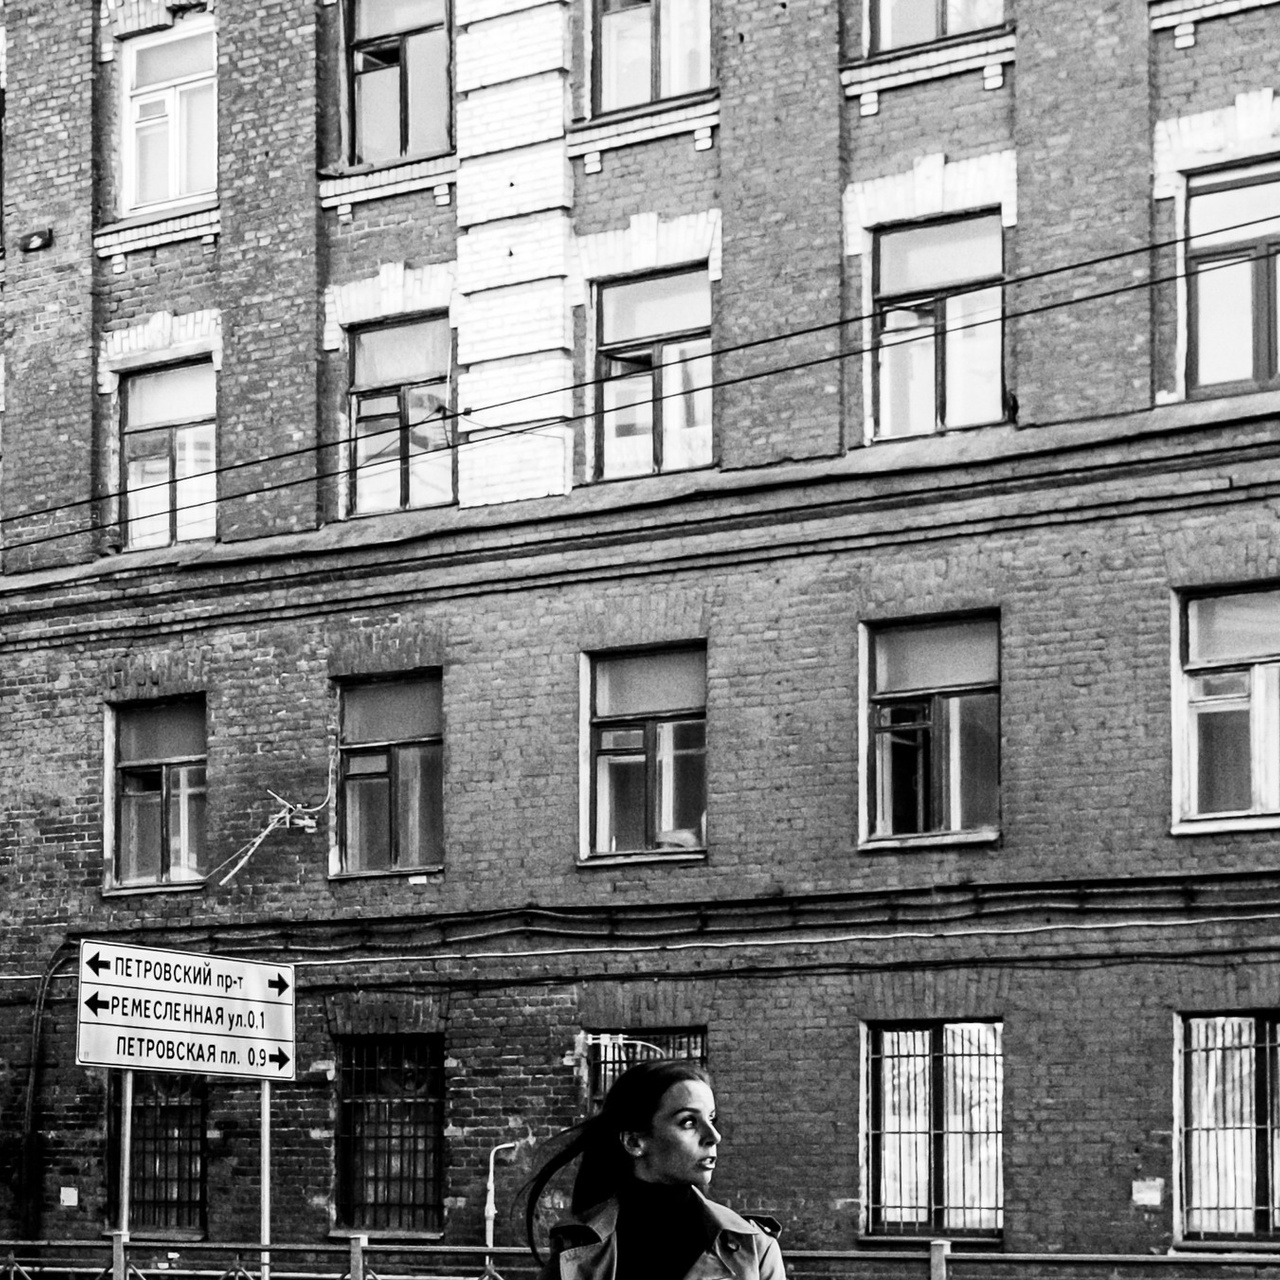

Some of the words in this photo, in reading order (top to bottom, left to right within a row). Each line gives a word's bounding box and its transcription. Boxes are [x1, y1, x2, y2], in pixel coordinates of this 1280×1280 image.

[115, 956, 212, 986] ПЕТРОВСКИЙ
[216, 973, 244, 993] пр-т
[111, 995, 224, 1026] РЕМЕСЛЕННАЯ
[116, 1035, 216, 1063] ПЕТРОВСКАЯ
[220, 1050, 240, 1065] пл.
